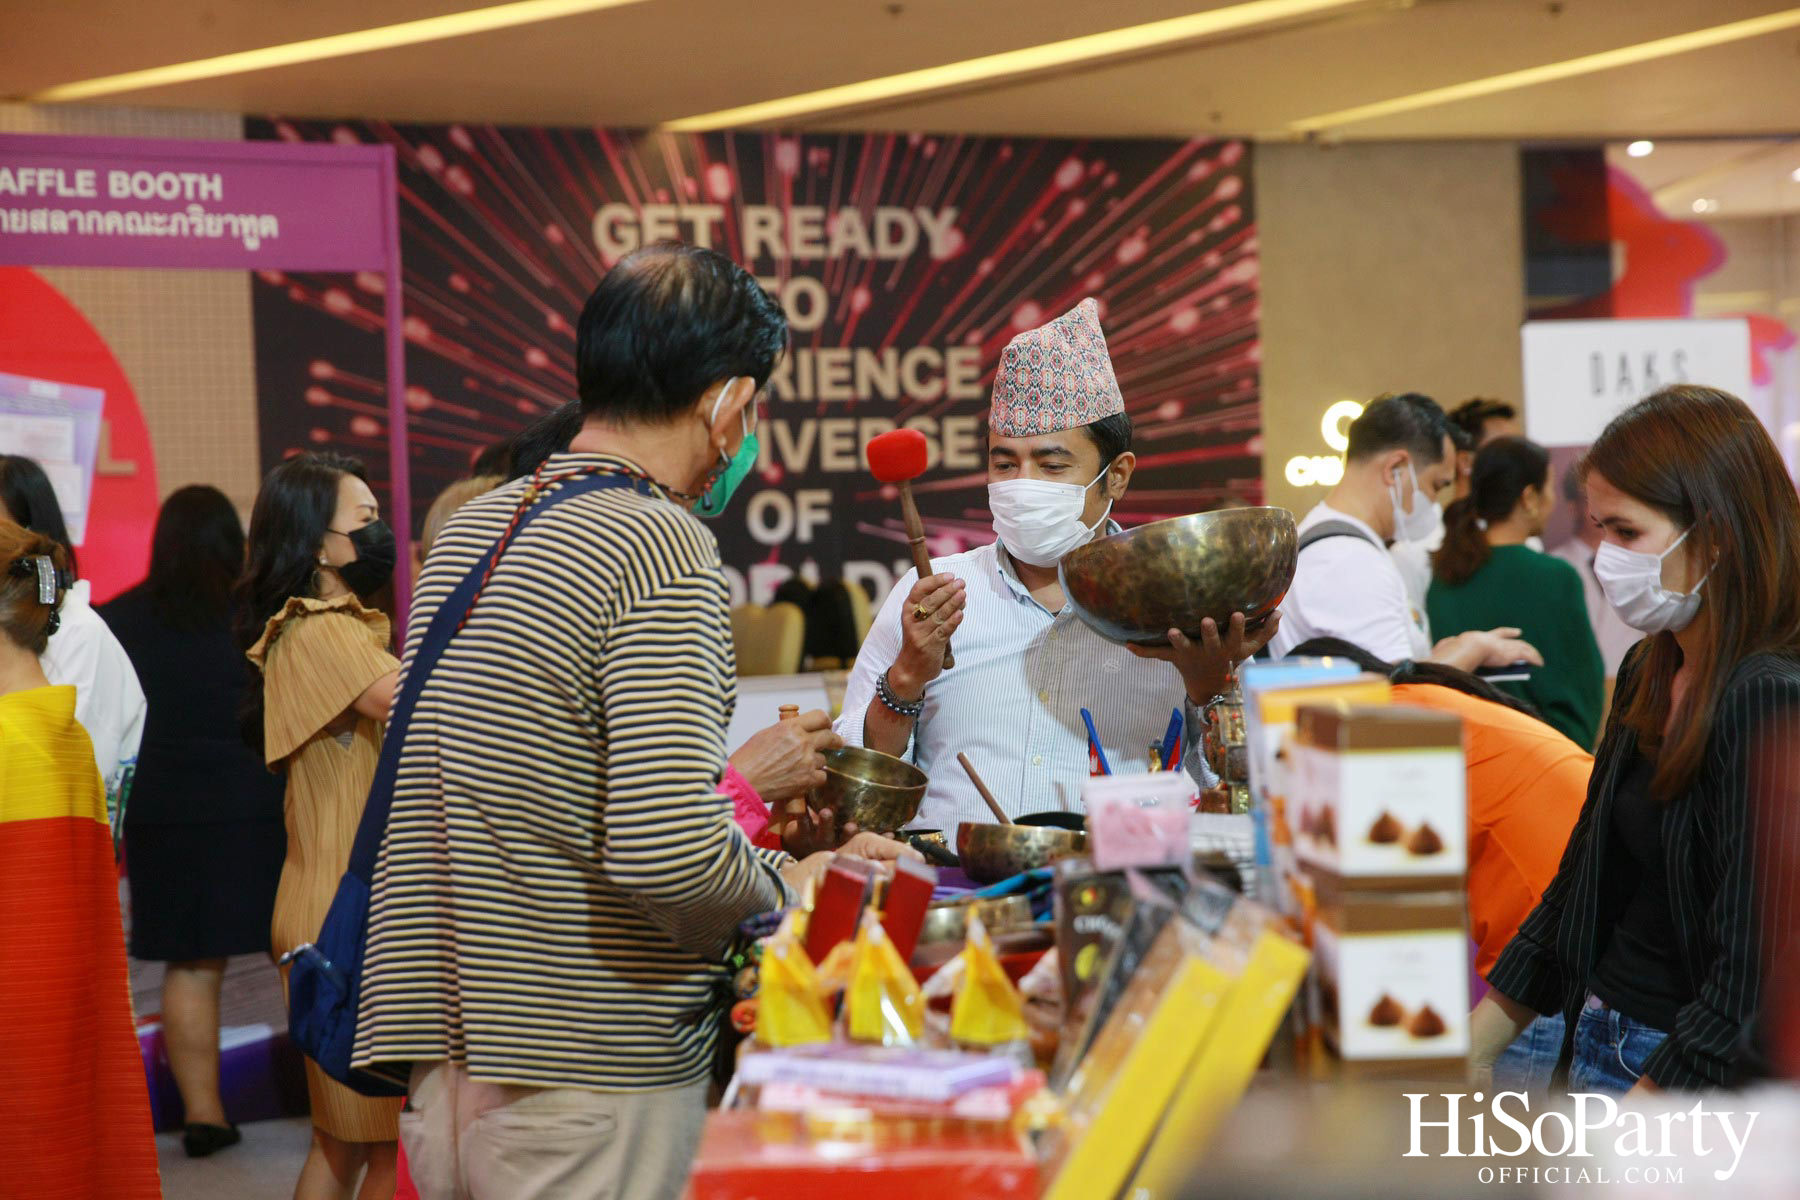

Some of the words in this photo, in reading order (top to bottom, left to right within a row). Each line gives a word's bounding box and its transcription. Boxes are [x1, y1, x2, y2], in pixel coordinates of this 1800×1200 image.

[0, 166, 98, 198] AFFLE
[108, 170, 223, 200] BOOTH
[592, 203, 724, 259] GET
[742, 205, 961, 260] READY
[768, 346, 983, 400] RIENCE
[747, 489, 833, 545] OF
